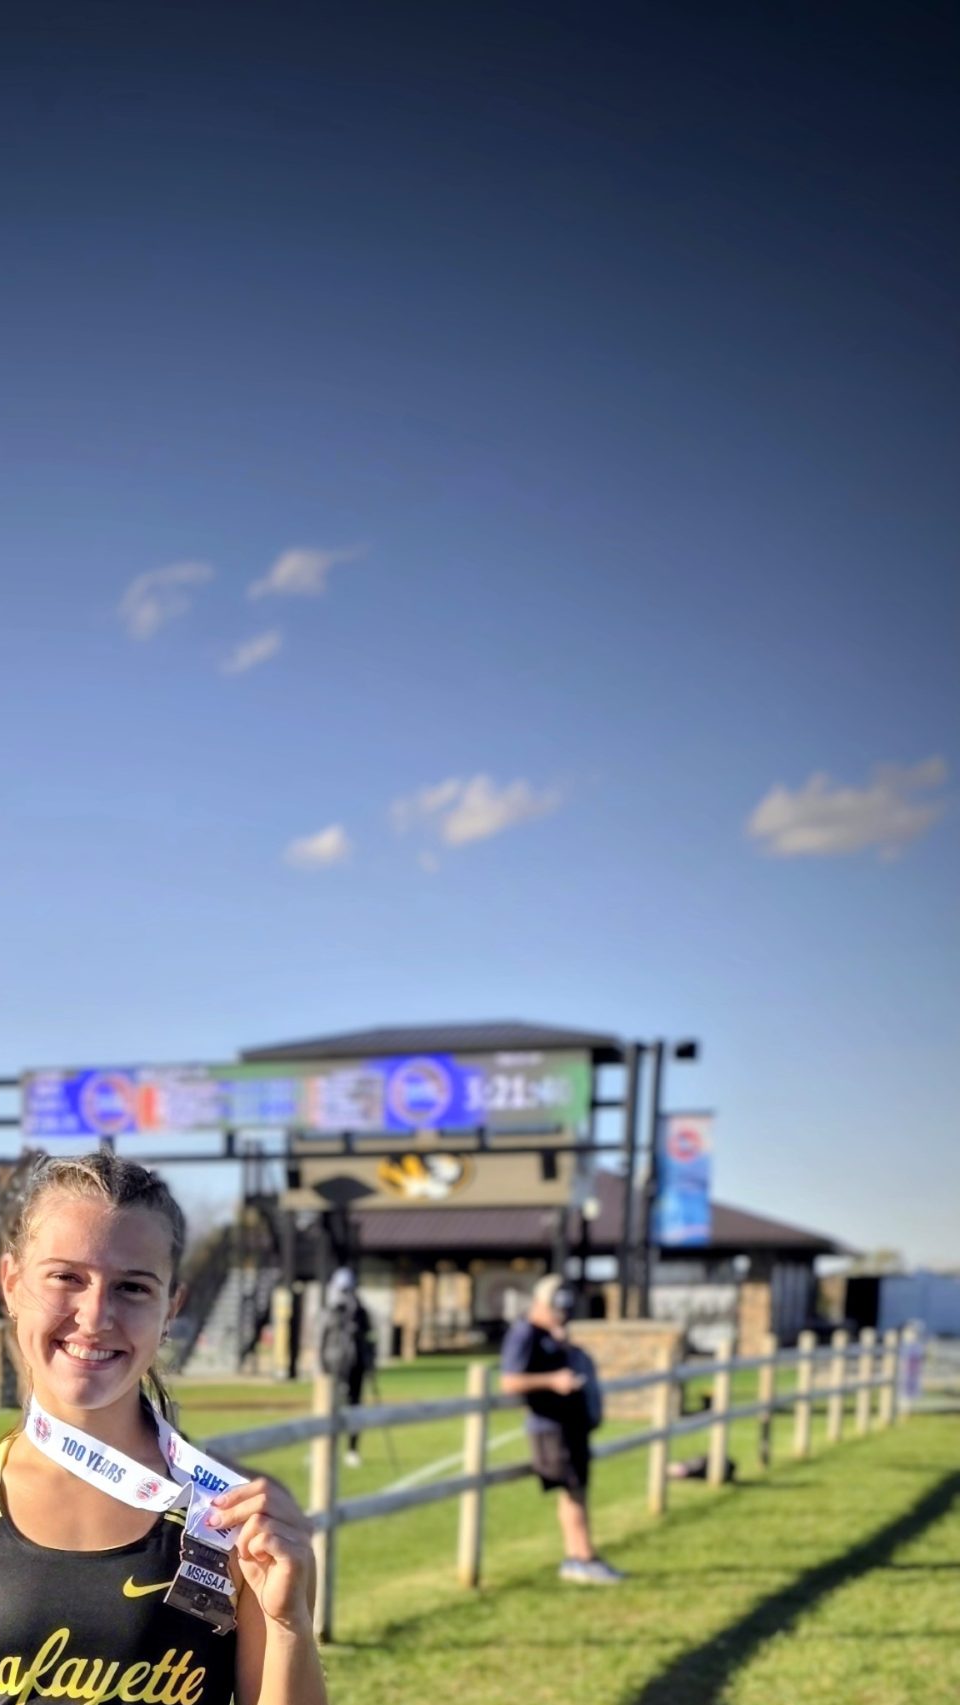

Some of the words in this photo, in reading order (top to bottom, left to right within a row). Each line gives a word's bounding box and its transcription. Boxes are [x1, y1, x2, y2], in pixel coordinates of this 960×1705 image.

[62, 1436, 86, 1462] 100
[86, 1450, 127, 1484] YEARS
[185, 1564, 227, 1592] MSHSAA
